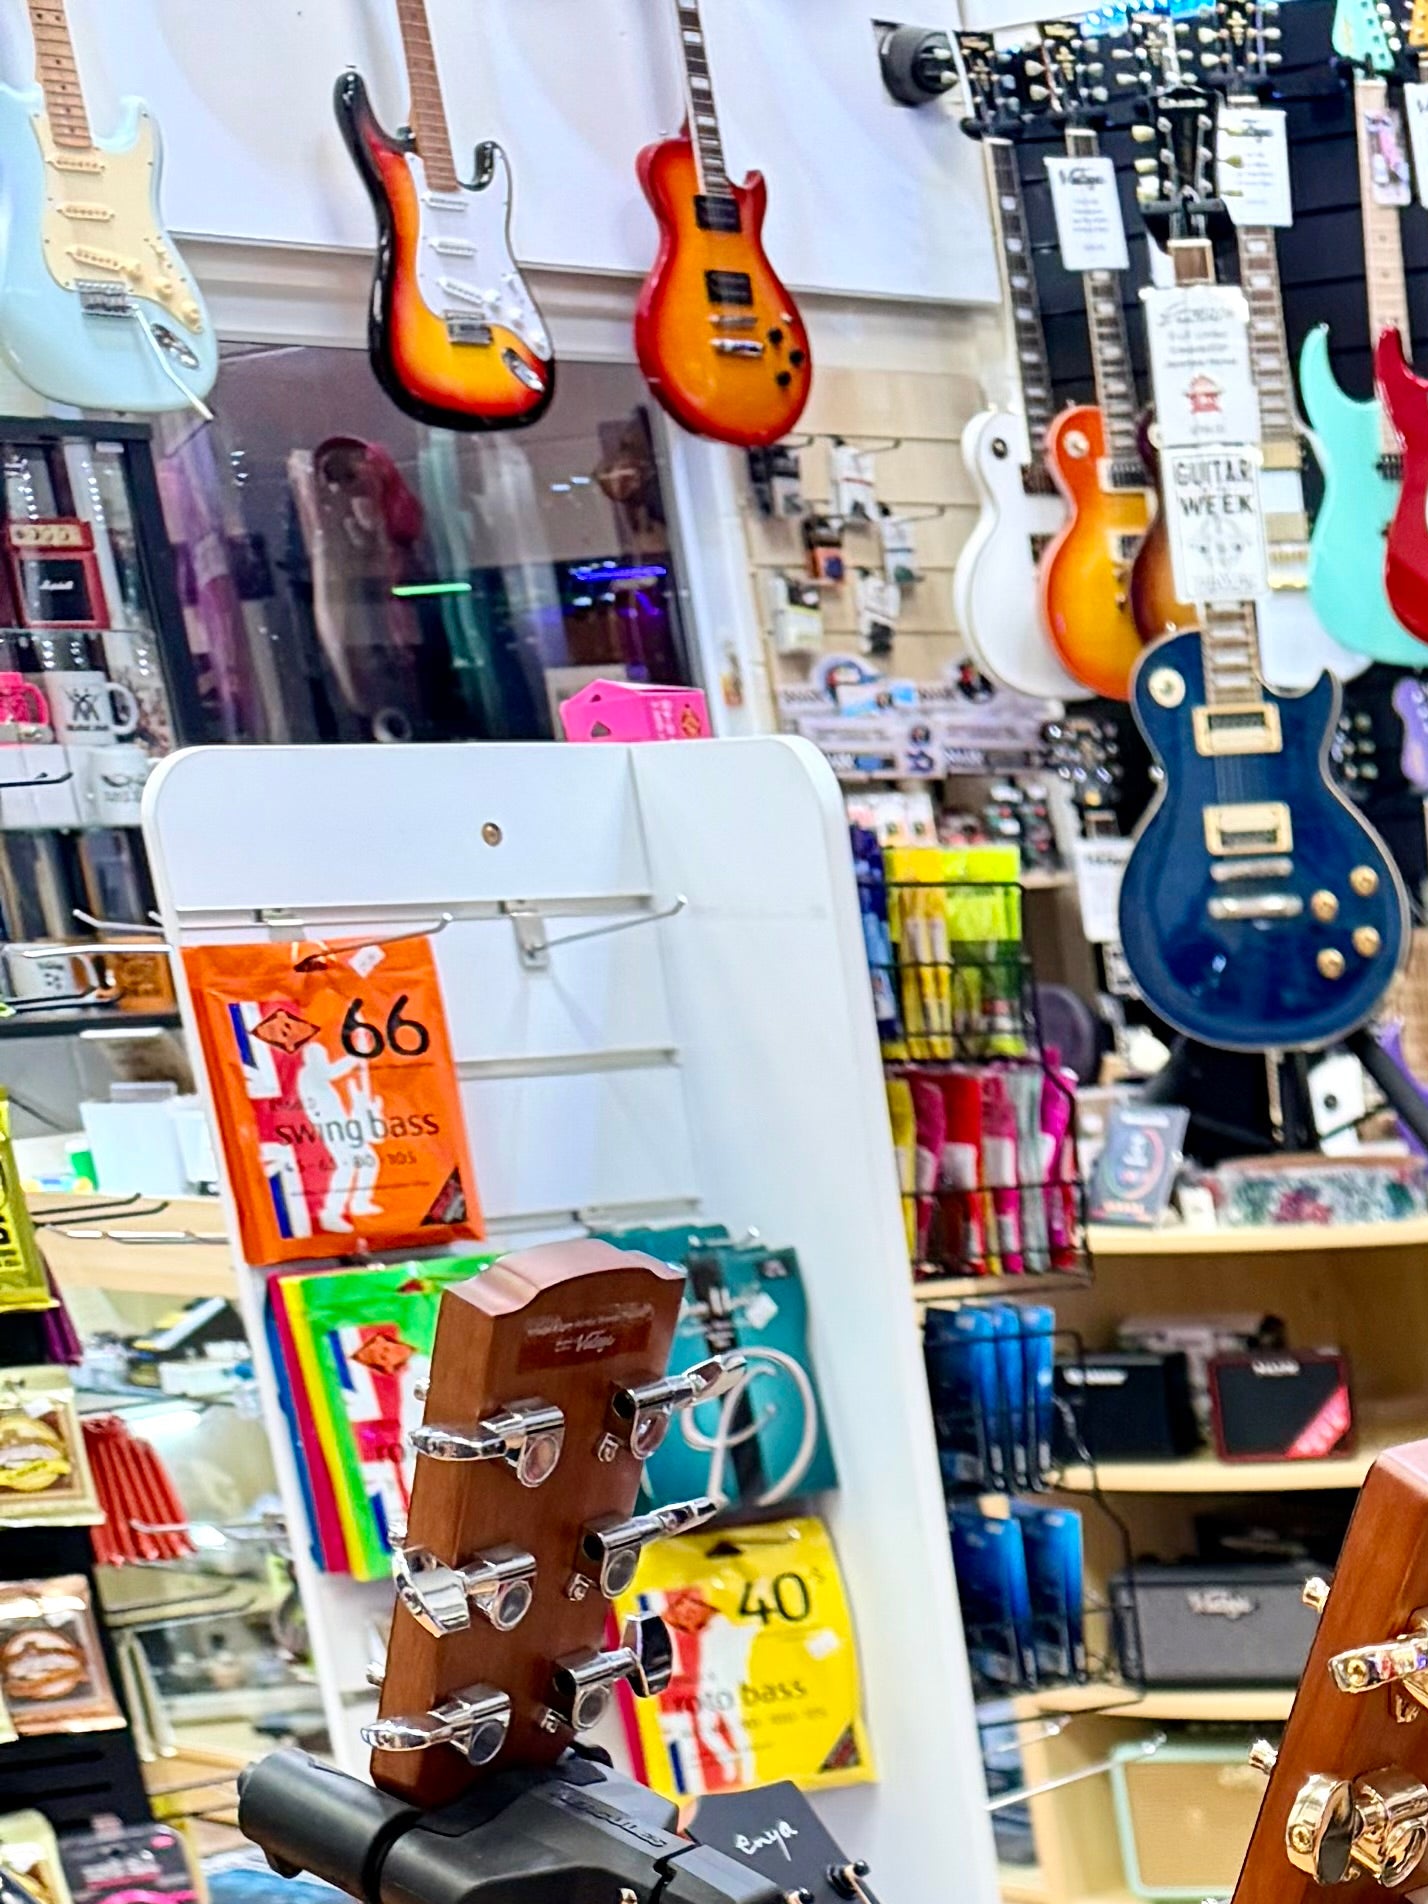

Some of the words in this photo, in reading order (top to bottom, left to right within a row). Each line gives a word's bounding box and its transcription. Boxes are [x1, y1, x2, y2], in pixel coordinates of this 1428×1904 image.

[341, 994, 430, 1059] 66
[274, 1112, 365, 1149] swing
[366, 1109, 440, 1138] bass
[740, 1680, 808, 1708] bass
[735, 1817, 799, 1862] enya
